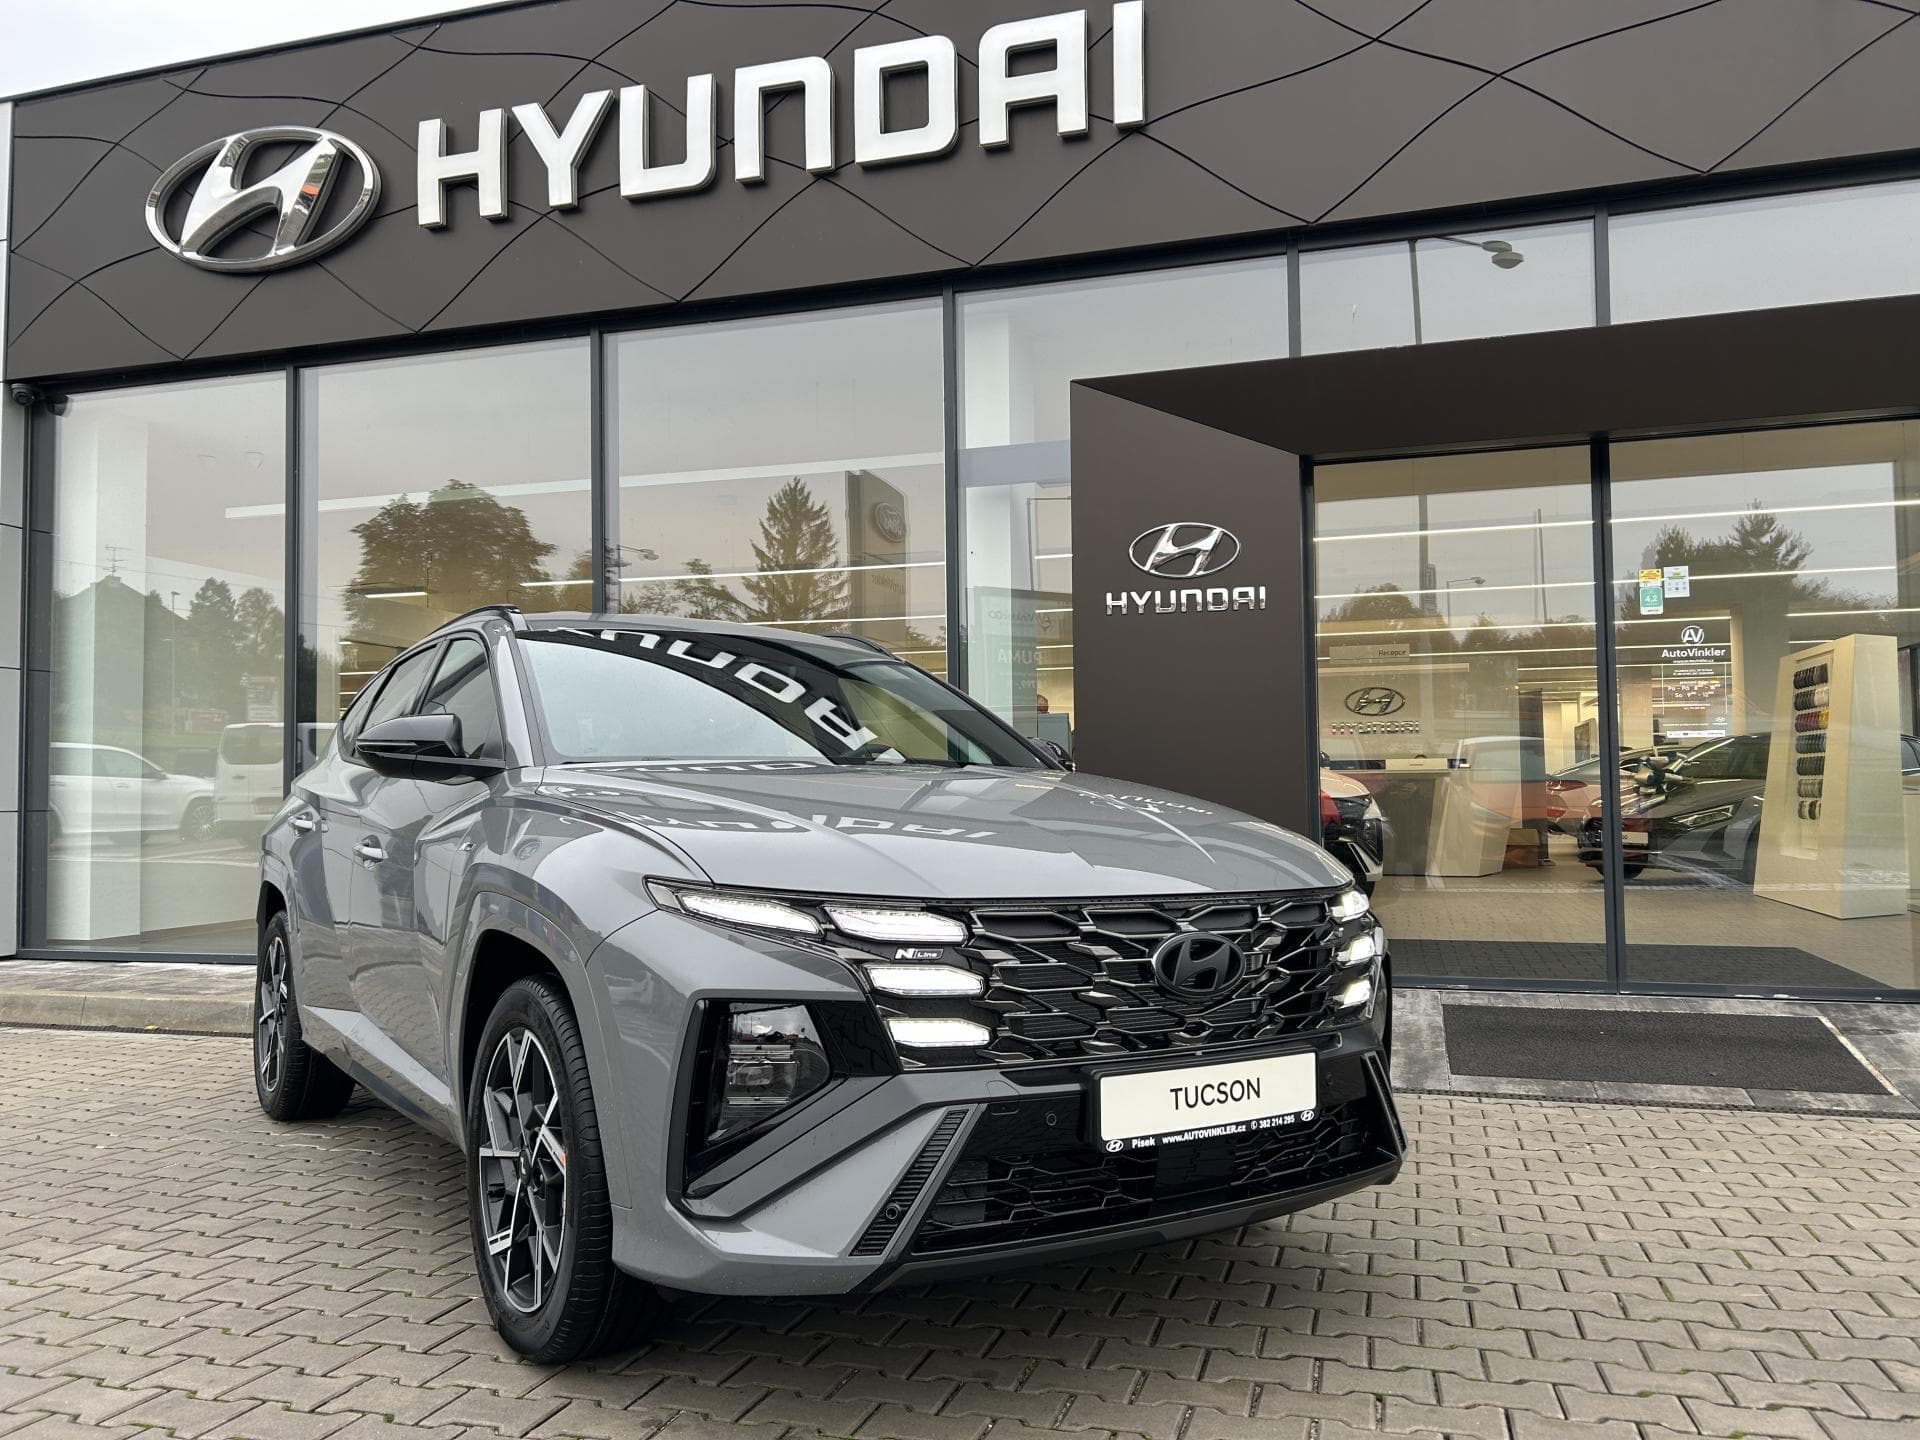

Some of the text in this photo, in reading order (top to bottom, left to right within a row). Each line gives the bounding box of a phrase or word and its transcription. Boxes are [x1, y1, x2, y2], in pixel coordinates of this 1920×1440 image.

[417, 0, 1146, 230] HYUNDAI
[1105, 586, 1267, 616] HYUNDAI
[1661, 648, 1726, 658] AutoVinkler
[1331, 720, 1420, 735] HYUNDAI
[1169, 1077, 1261, 1110] TUCSON
[1162, 1125, 1246, 1144] www.AUTOVINKLER.cz
[1259, 1119, 1271, 1129] 382
[1271, 1117, 1283, 1127] 214
